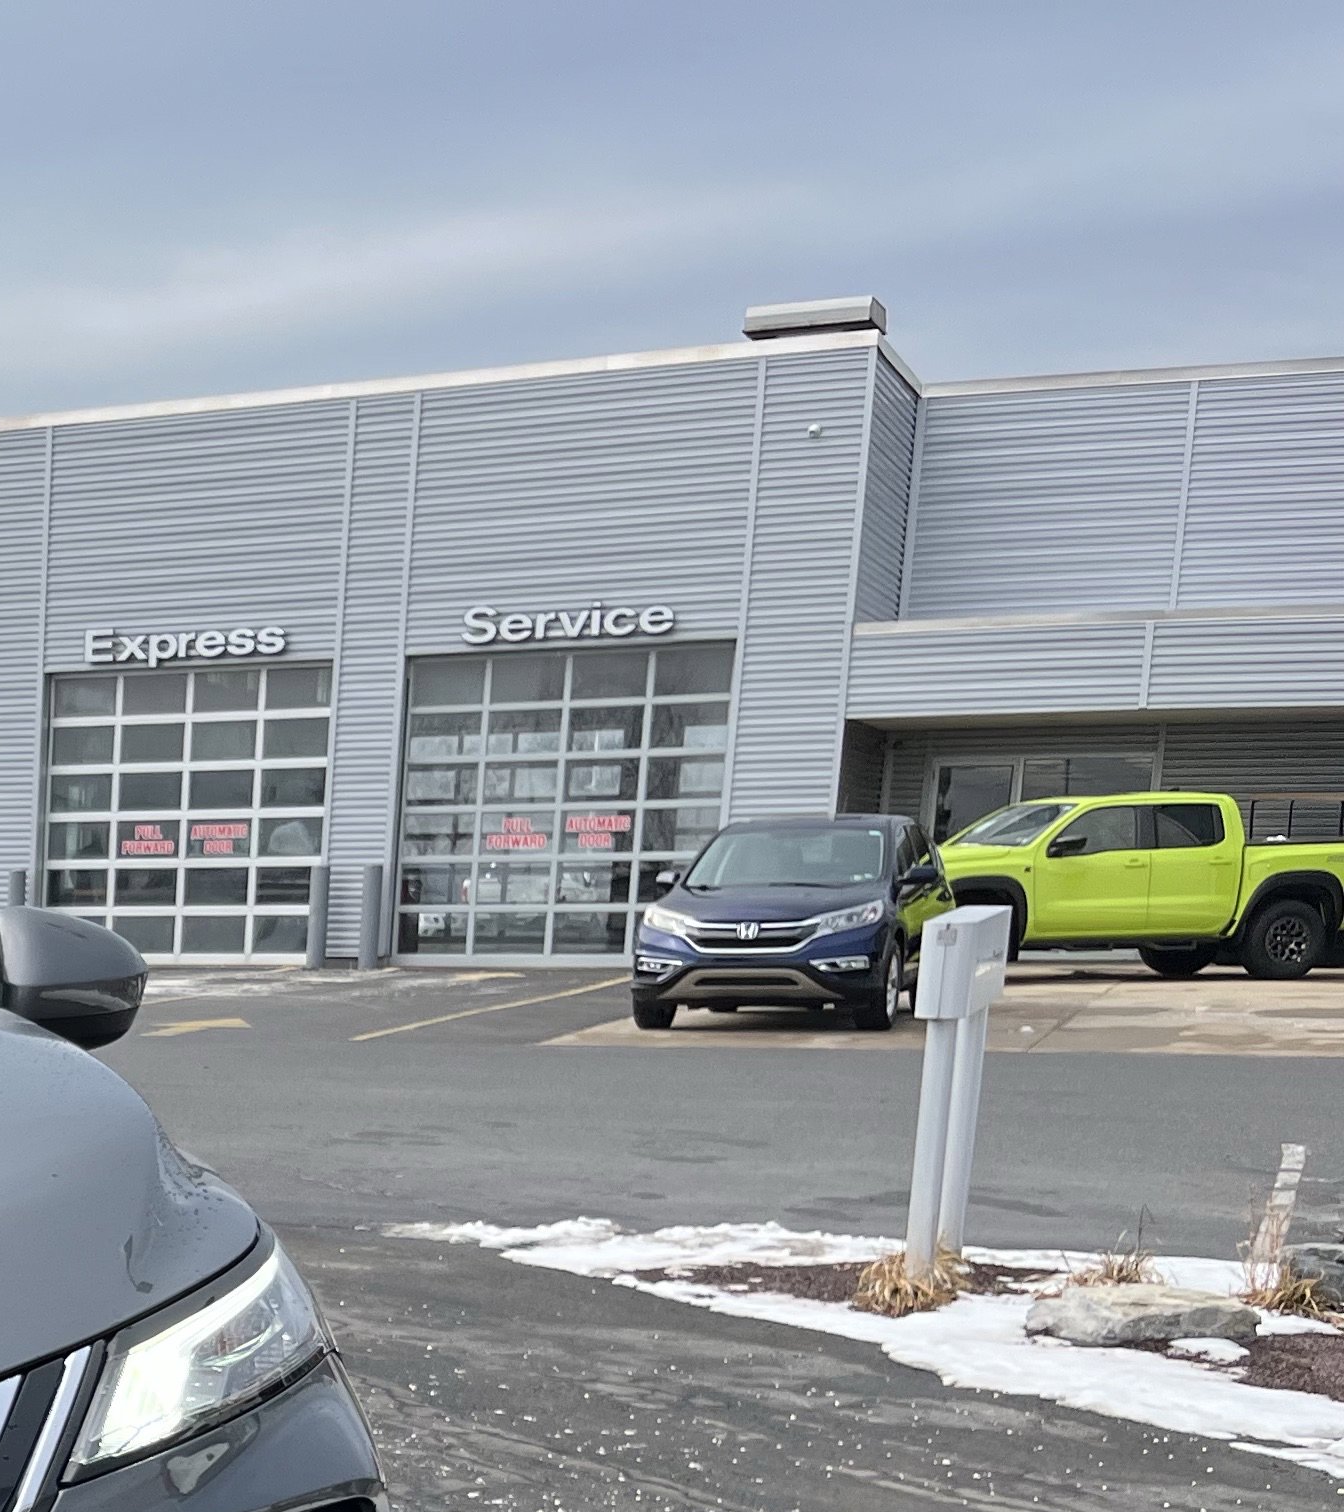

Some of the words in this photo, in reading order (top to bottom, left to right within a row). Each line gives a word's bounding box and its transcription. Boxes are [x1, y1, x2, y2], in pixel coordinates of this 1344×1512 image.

[462, 601, 674, 644] Service
[85, 626, 286, 668] Express
[502, 817, 533, 833] PULL
[566, 815, 631, 832] AUTOMATIC
[191, 824, 248, 840] AUTOMATIC
[121, 840, 174, 855] FORWARD
[203, 840, 233, 854] DOOR
[486, 834, 547, 849] FORWARD
[577, 833, 611, 848] DOOR
